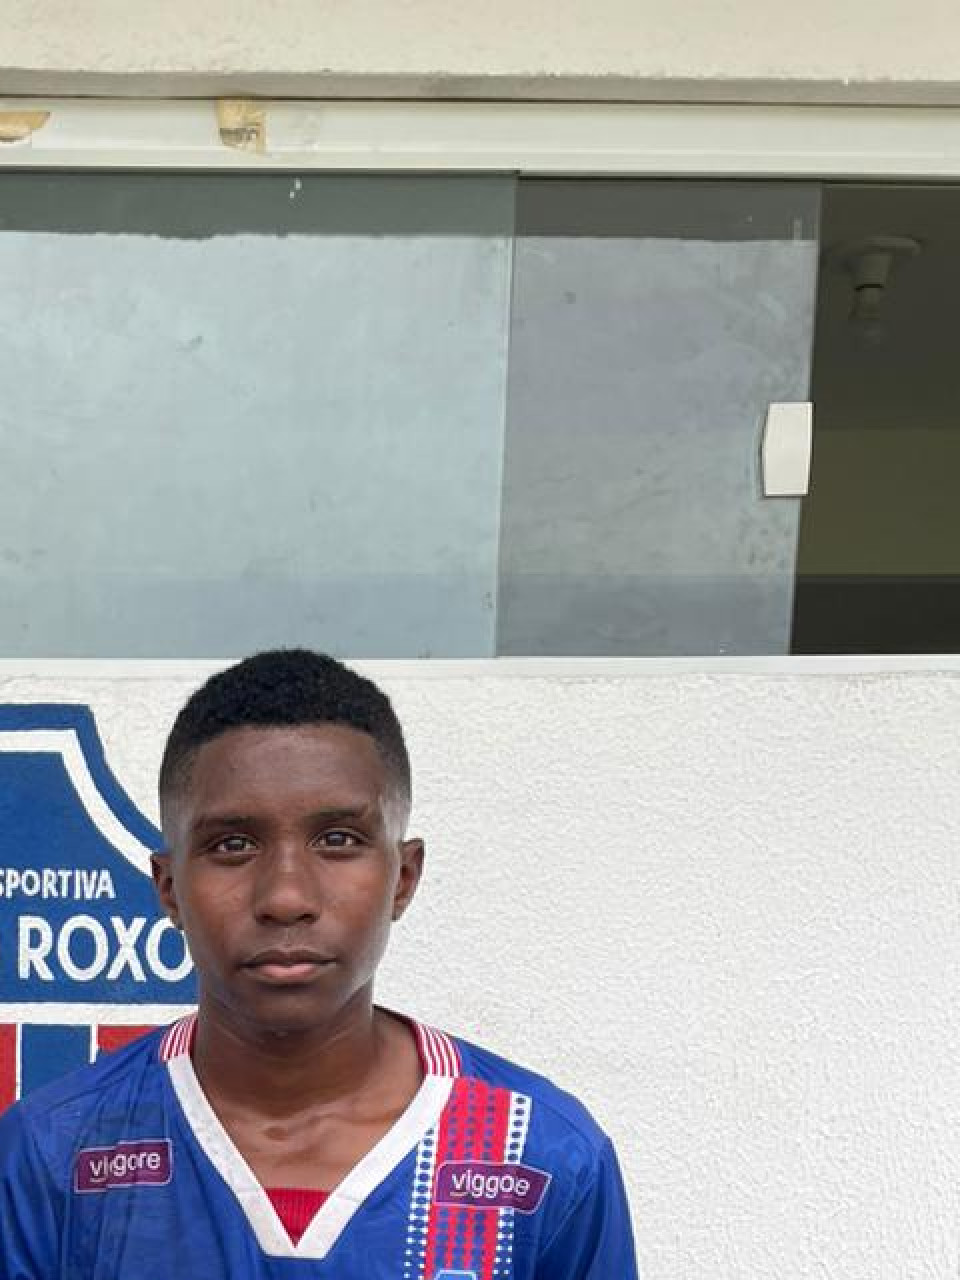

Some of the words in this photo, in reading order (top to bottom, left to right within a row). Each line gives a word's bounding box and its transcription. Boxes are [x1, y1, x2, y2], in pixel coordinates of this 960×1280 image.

[17, 914, 194, 983] ROXO
[90, 1152, 161, 1177] vigore
[452, 1169, 531, 1198] viggoe
